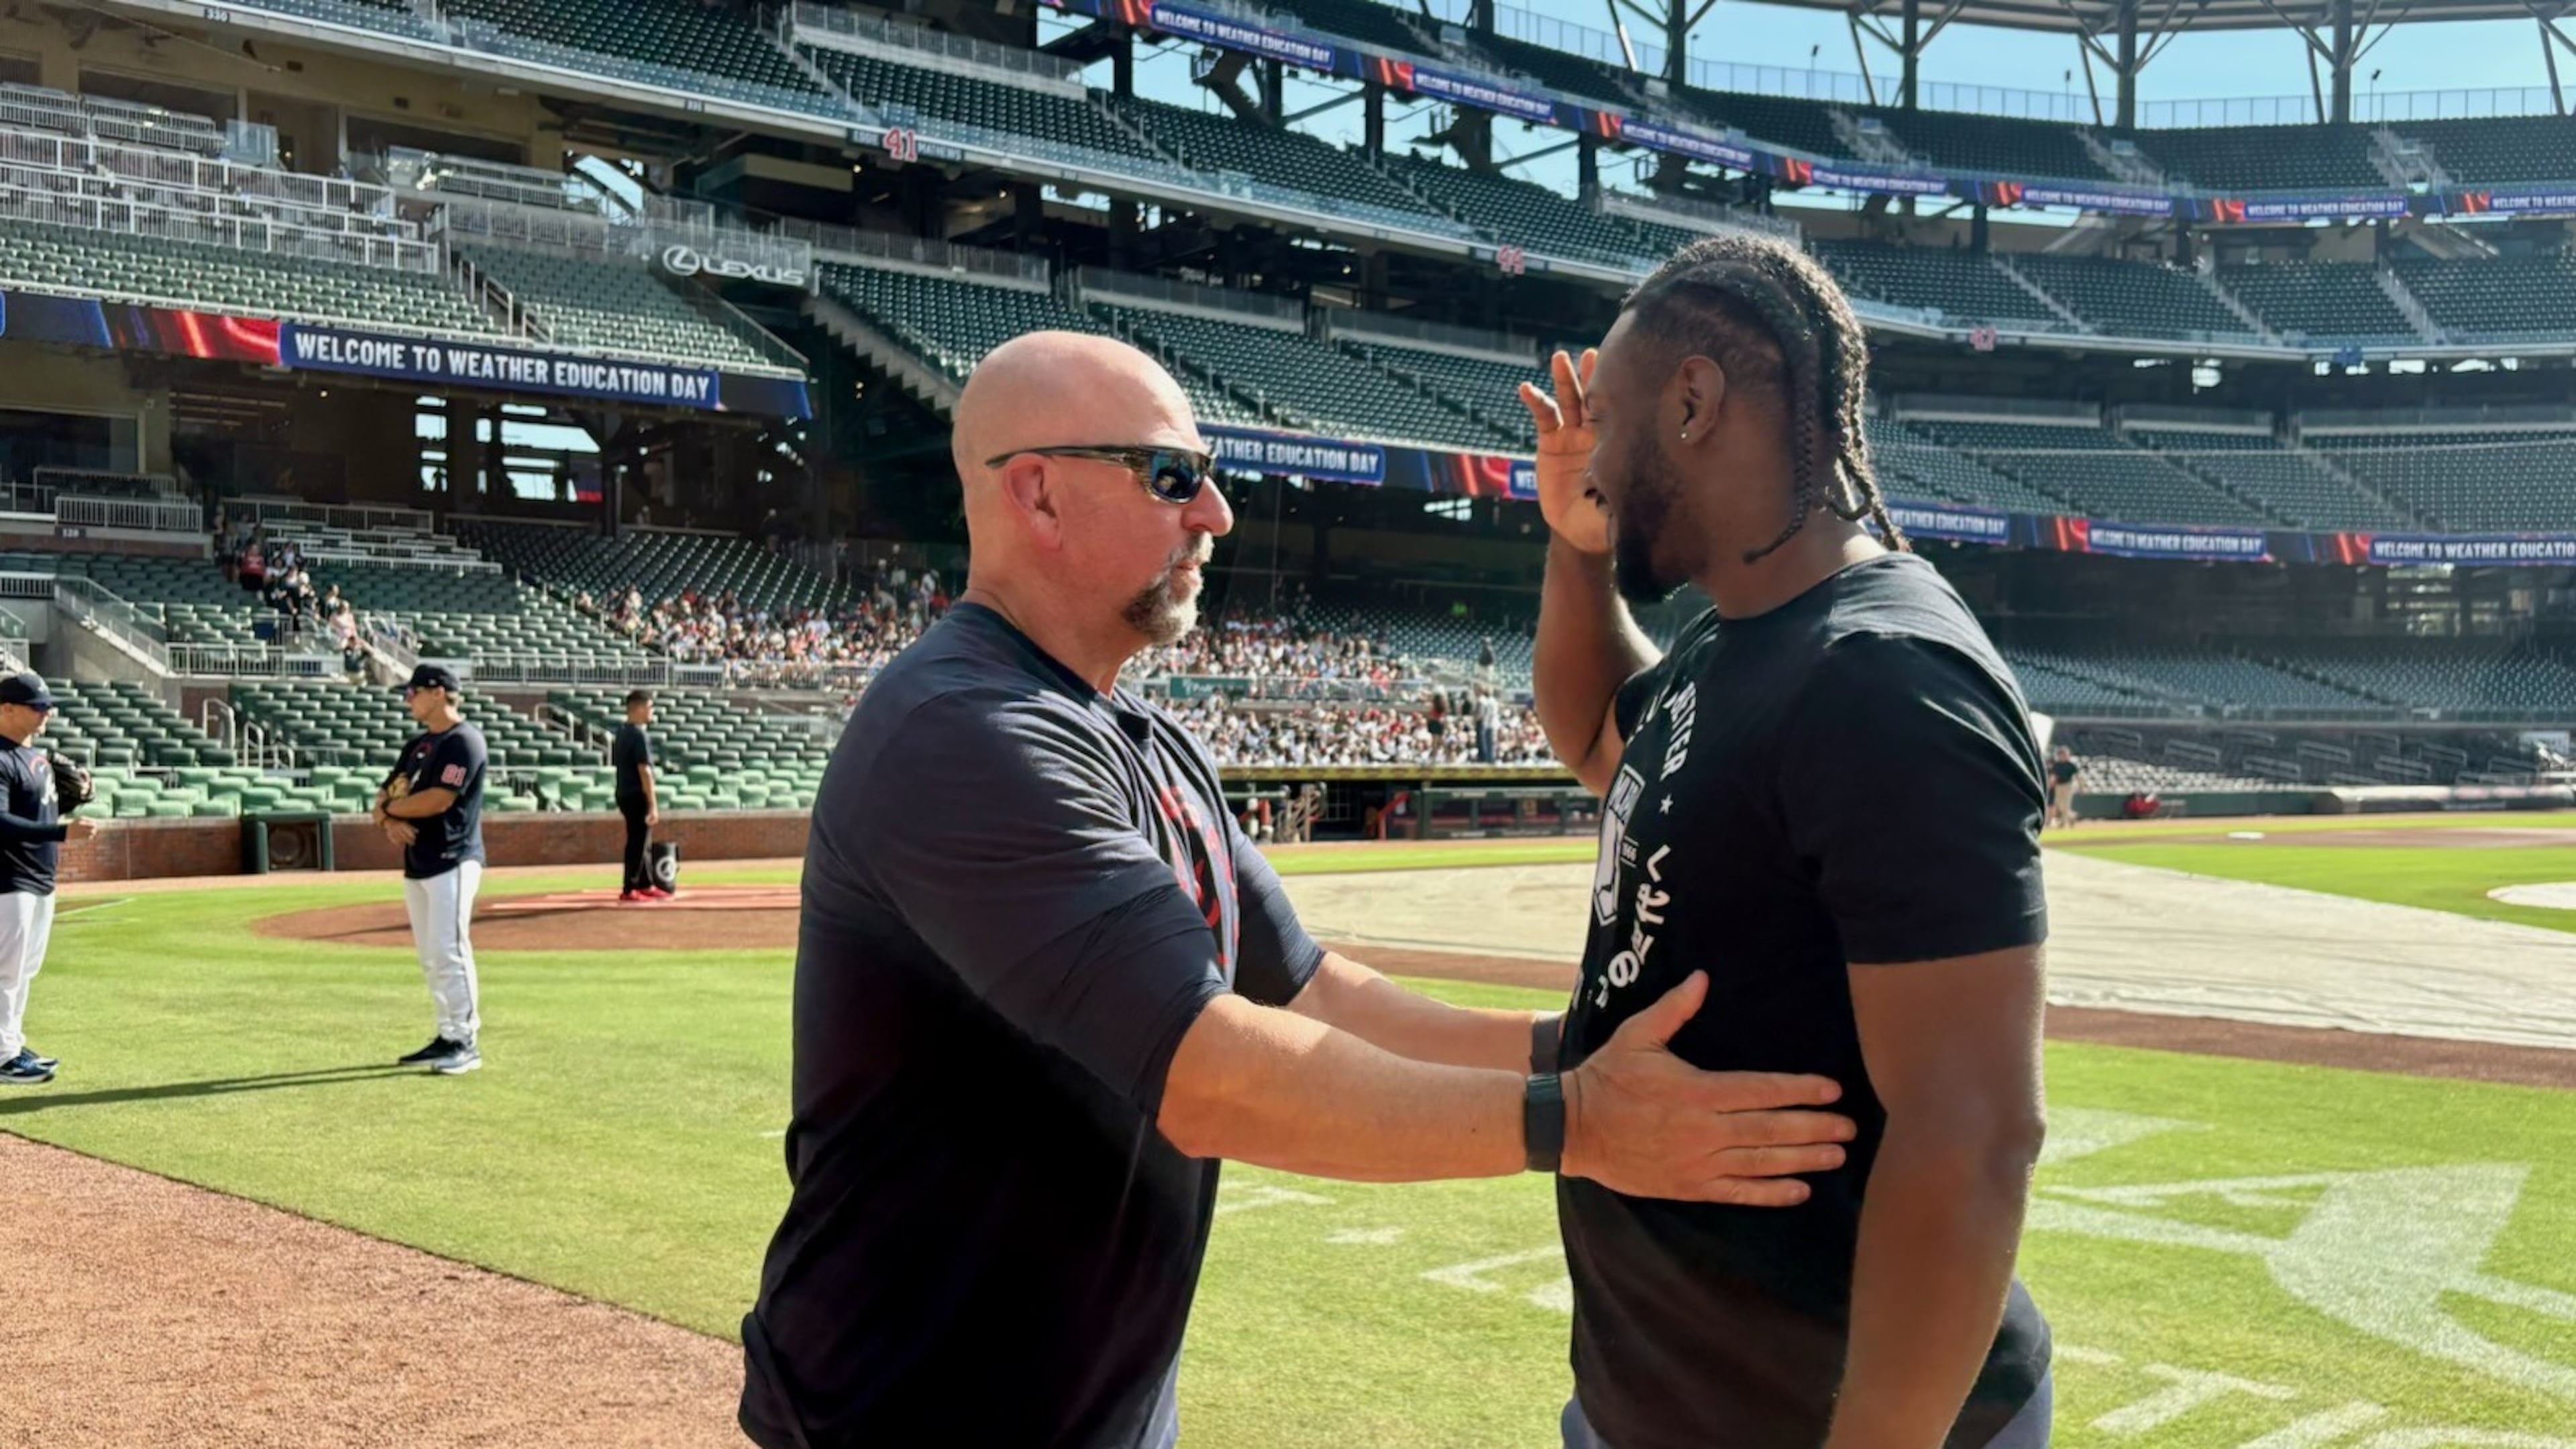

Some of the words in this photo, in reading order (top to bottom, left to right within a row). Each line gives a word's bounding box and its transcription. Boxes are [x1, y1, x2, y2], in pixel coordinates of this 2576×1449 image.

[1155, 9, 1201, 32] WELCOME
[1203, 21, 1216, 35] TO
[1217, 25, 1261, 46] WEATHER
[1262, 36, 1311, 58] EDUCATION
[883, 127, 918, 162] 41
[703, 256, 804, 286] LEXUS
[295, 333, 405, 369] WELCOME
[411, 345, 441, 372] TO
[447, 349, 548, 384] WEATHER
[555, 361, 665, 395] EDUCATION
[672, 373, 709, 400] DAY
[1267, 442, 1347, 470] EDUCATION
[1349, 451, 1379, 473] DAY
[1936, 513, 1986, 533] EDUCATION
[2090, 529, 2124, 547] WELCOME
[2125, 531, 2135, 549] TO
[2137, 532, 2180, 551] WEATHER
[2182, 535, 2239, 553] EDUCATION
[2241, 537, 2262, 553] DAY
[2375, 542, 2425, 558] WELCOME
[2428, 542, 2442, 558] TO
[2445, 542, 2508, 558] WEATHER
[2510, 541, 2576, 557] EDUCATIO
